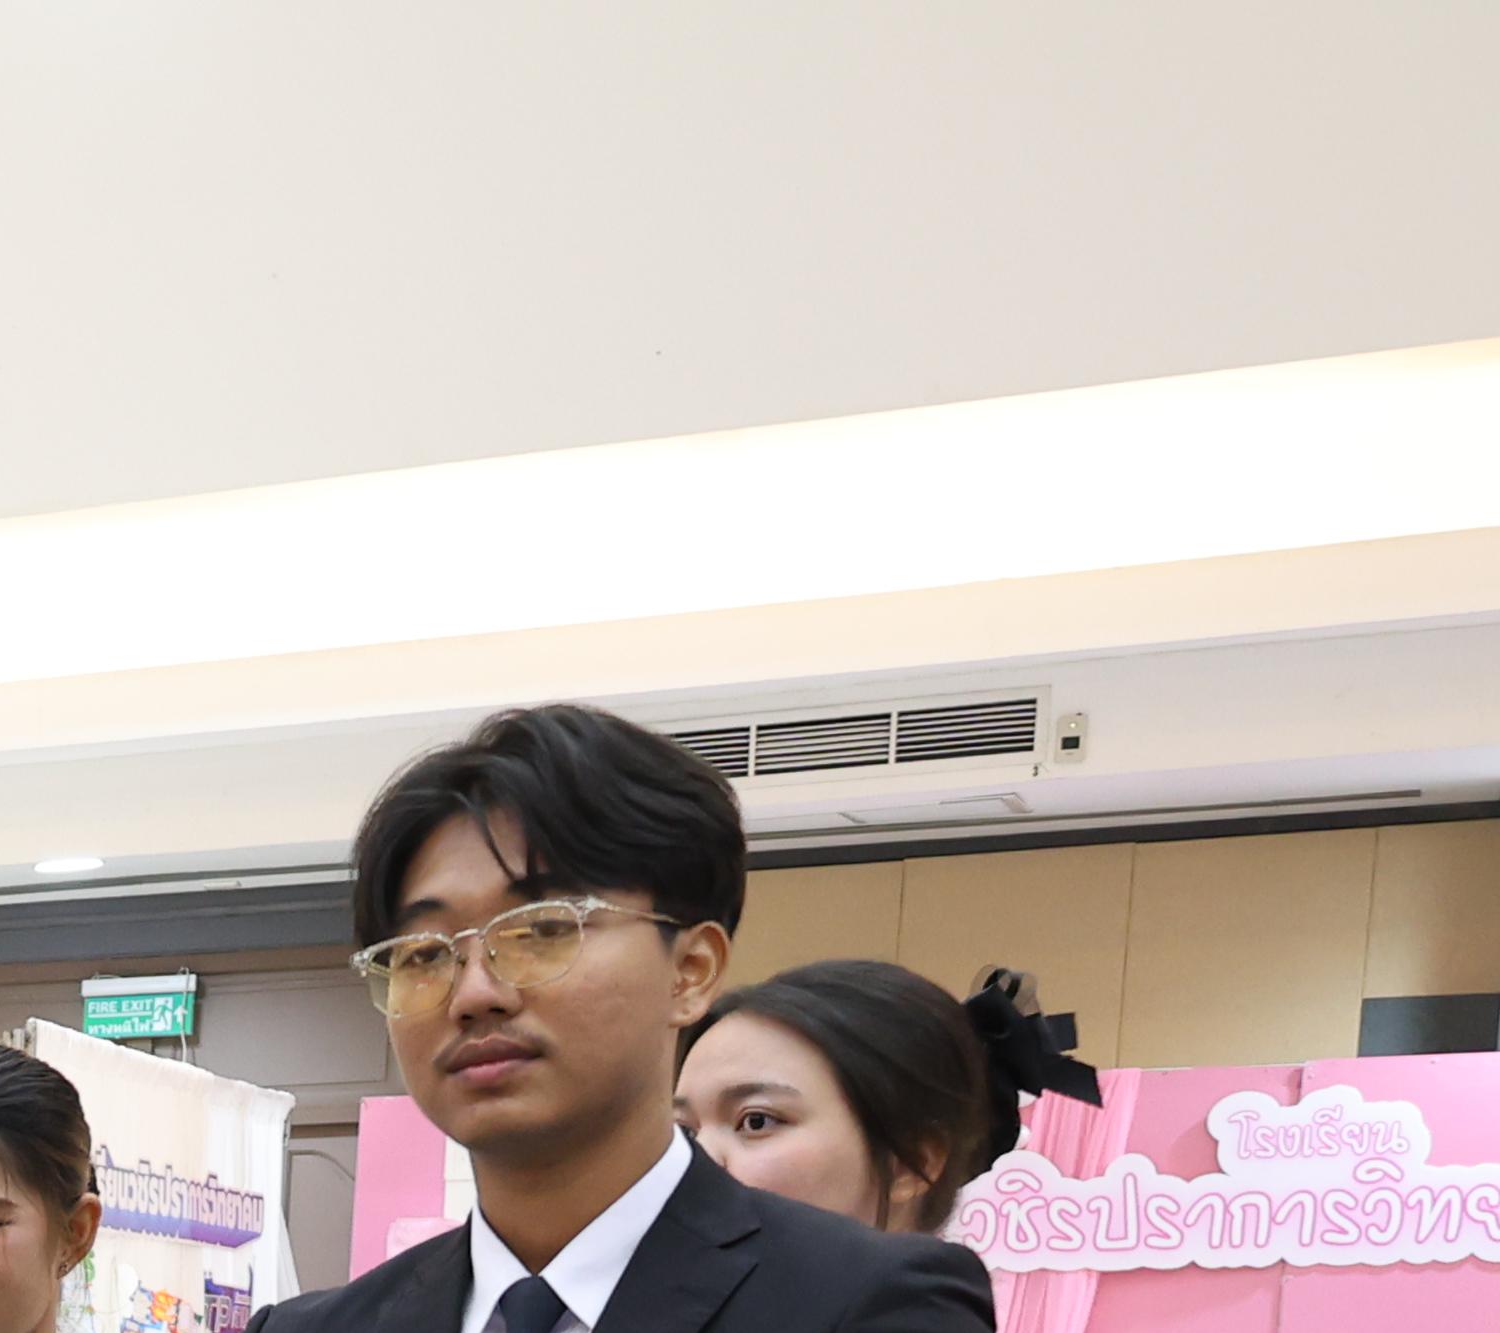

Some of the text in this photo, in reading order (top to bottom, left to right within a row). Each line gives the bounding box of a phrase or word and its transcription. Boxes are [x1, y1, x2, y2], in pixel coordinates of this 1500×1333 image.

[88, 998, 154, 1015] FIRE EXIT
[1228, 1103, 1411, 1161] โรงเรียน
